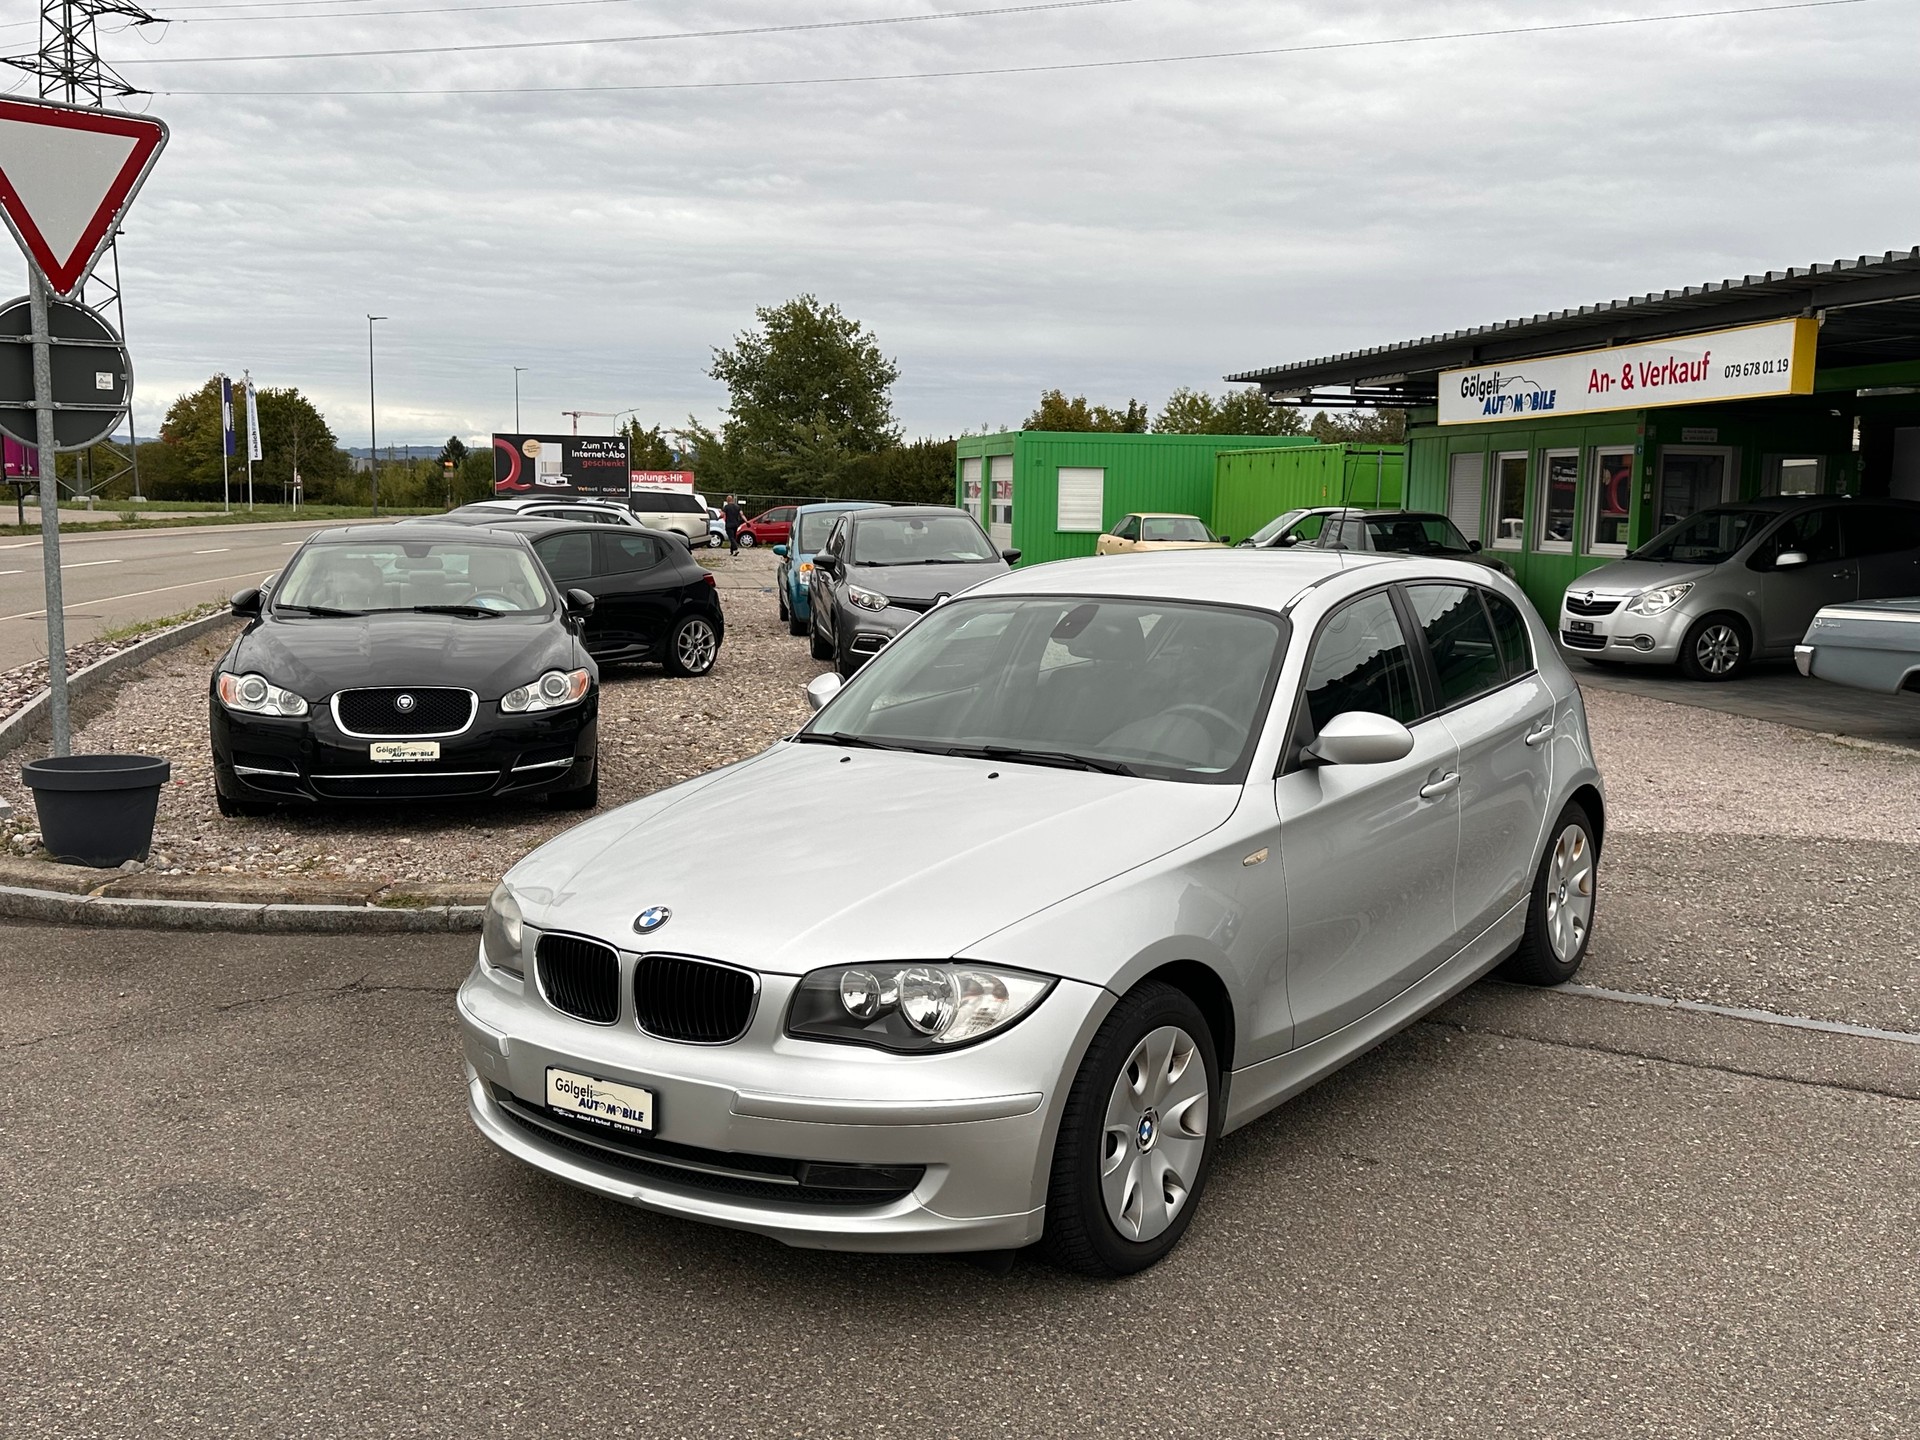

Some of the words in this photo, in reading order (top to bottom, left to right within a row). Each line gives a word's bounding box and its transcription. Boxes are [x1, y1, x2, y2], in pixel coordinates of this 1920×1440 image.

[1587, 368, 1616, 394] An-
[1621, 363, 1634, 390] &
[1638, 351, 1711, 388] Verkauf
[1724, 364, 1742, 379] 079
[1743, 361, 1761, 376] 678
[1762, 360, 1774, 374] 01
[1776, 358, 1789, 373] 19
[1461, 371, 1500, 402] Gölgeli
[581, 441, 600, 449] Zum
[602, 441, 616, 450] TV-
[618, 442, 626, 450] &
[571, 449, 626, 459] Internet-Abo
[582, 460, 625, 468] geschenkt
[375, 746, 402, 754] Gölgeli
[555, 1077, 593, 1099] Gölgeli
